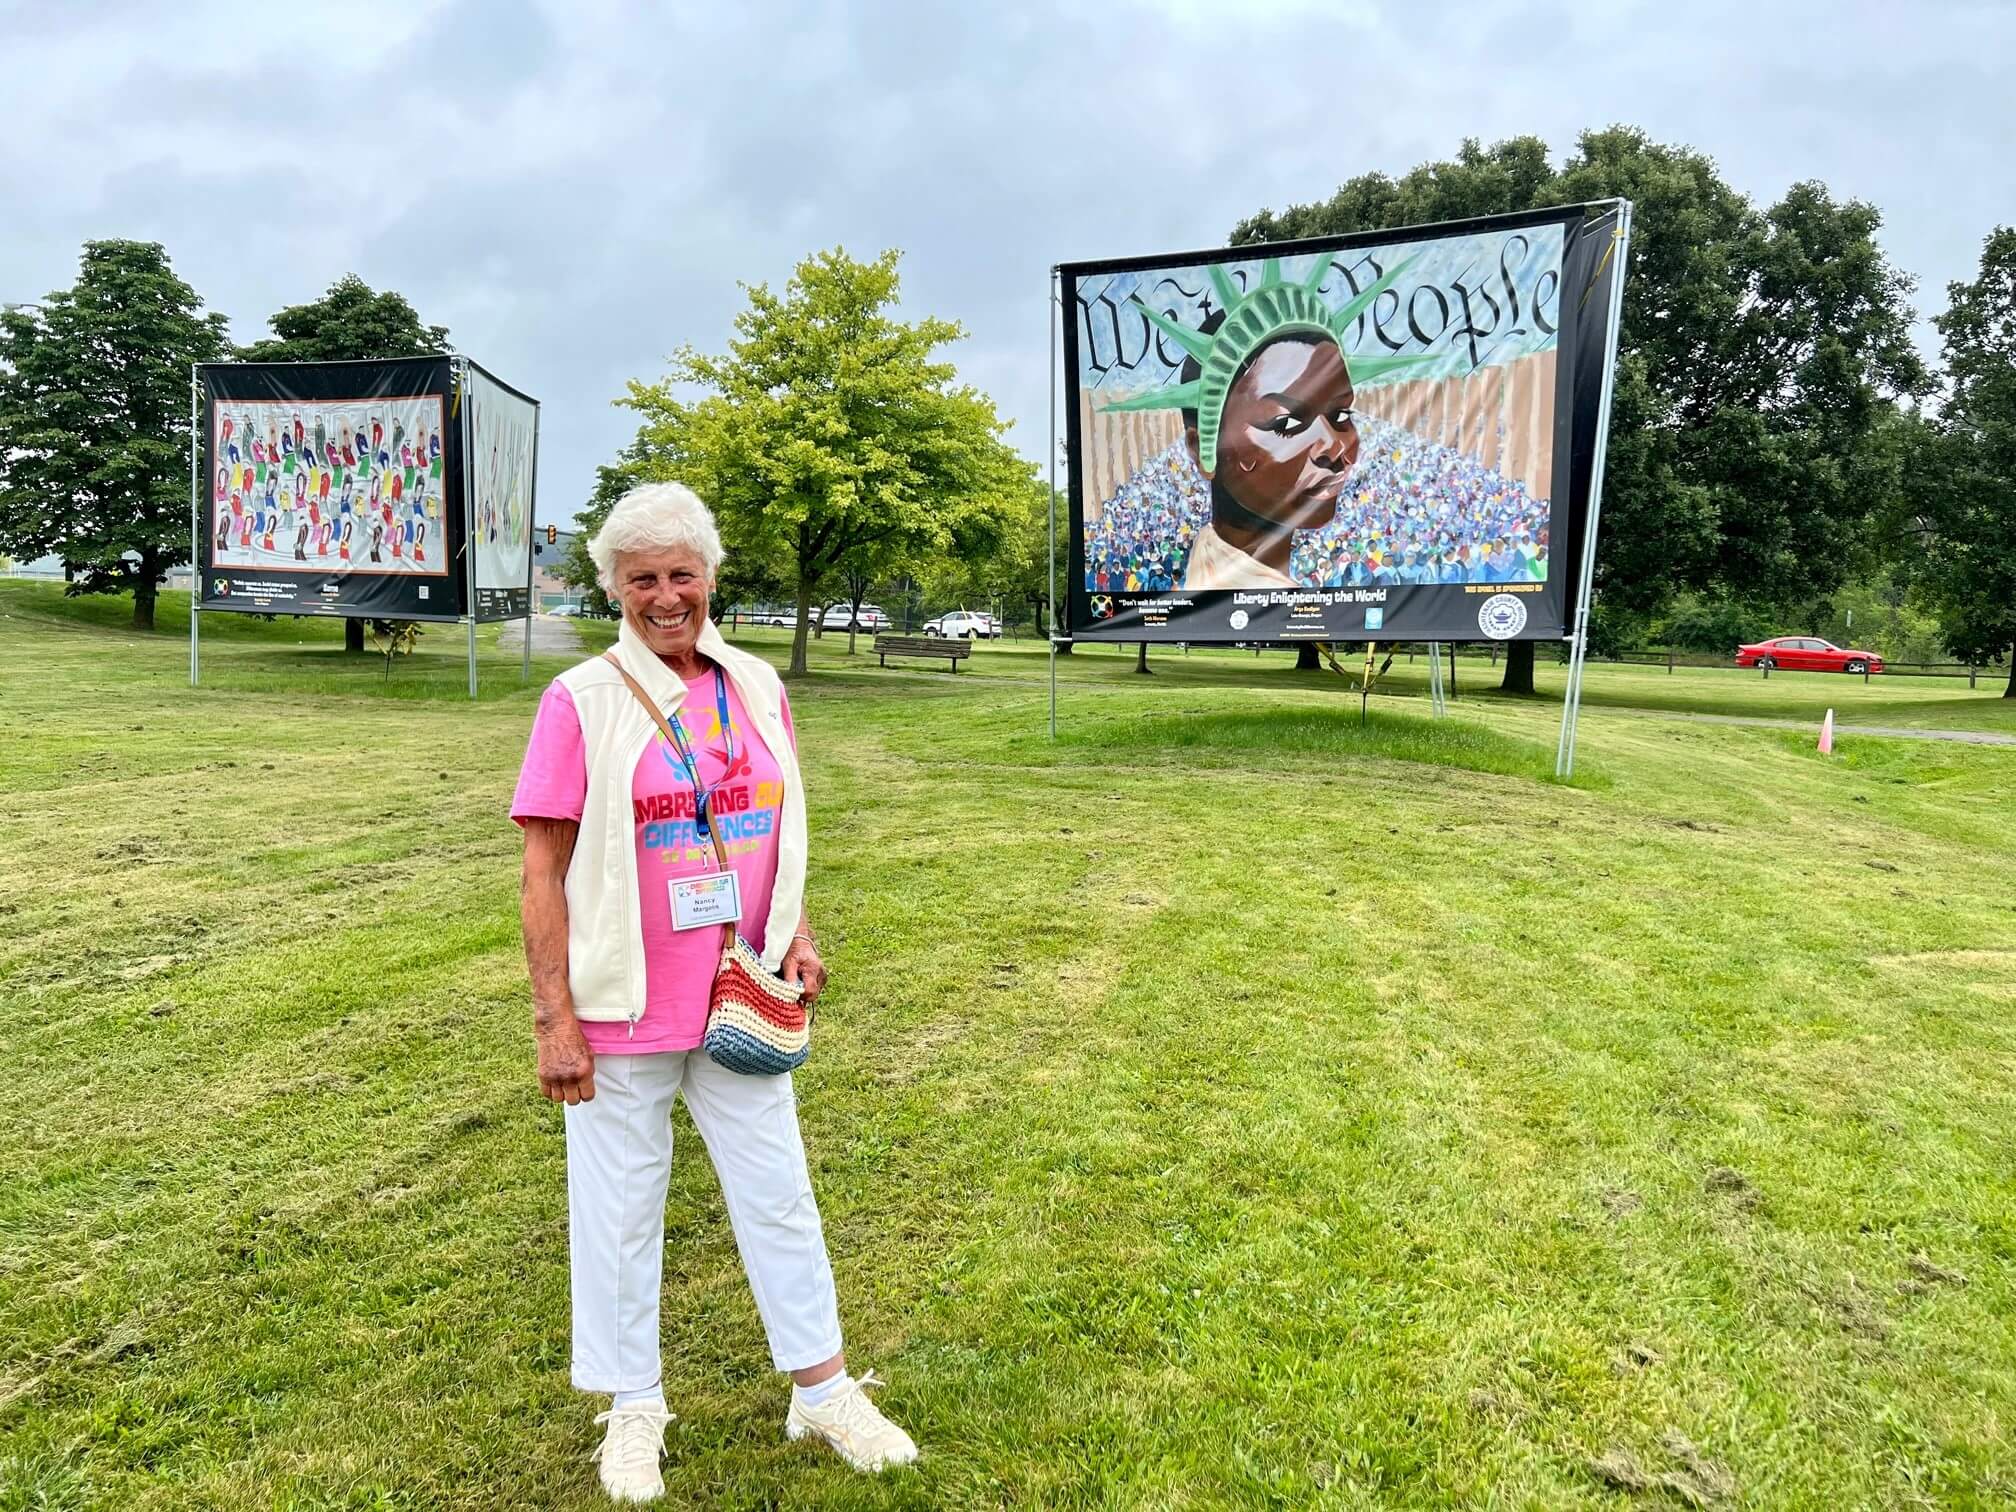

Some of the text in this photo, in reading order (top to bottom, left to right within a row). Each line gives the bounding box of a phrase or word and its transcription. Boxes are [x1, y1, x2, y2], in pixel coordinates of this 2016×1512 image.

[1316, 235, 1558, 378] People
[1233, 589, 1387, 607] Liberty Enlightening the World
[694, 897, 716, 905] Nancy
